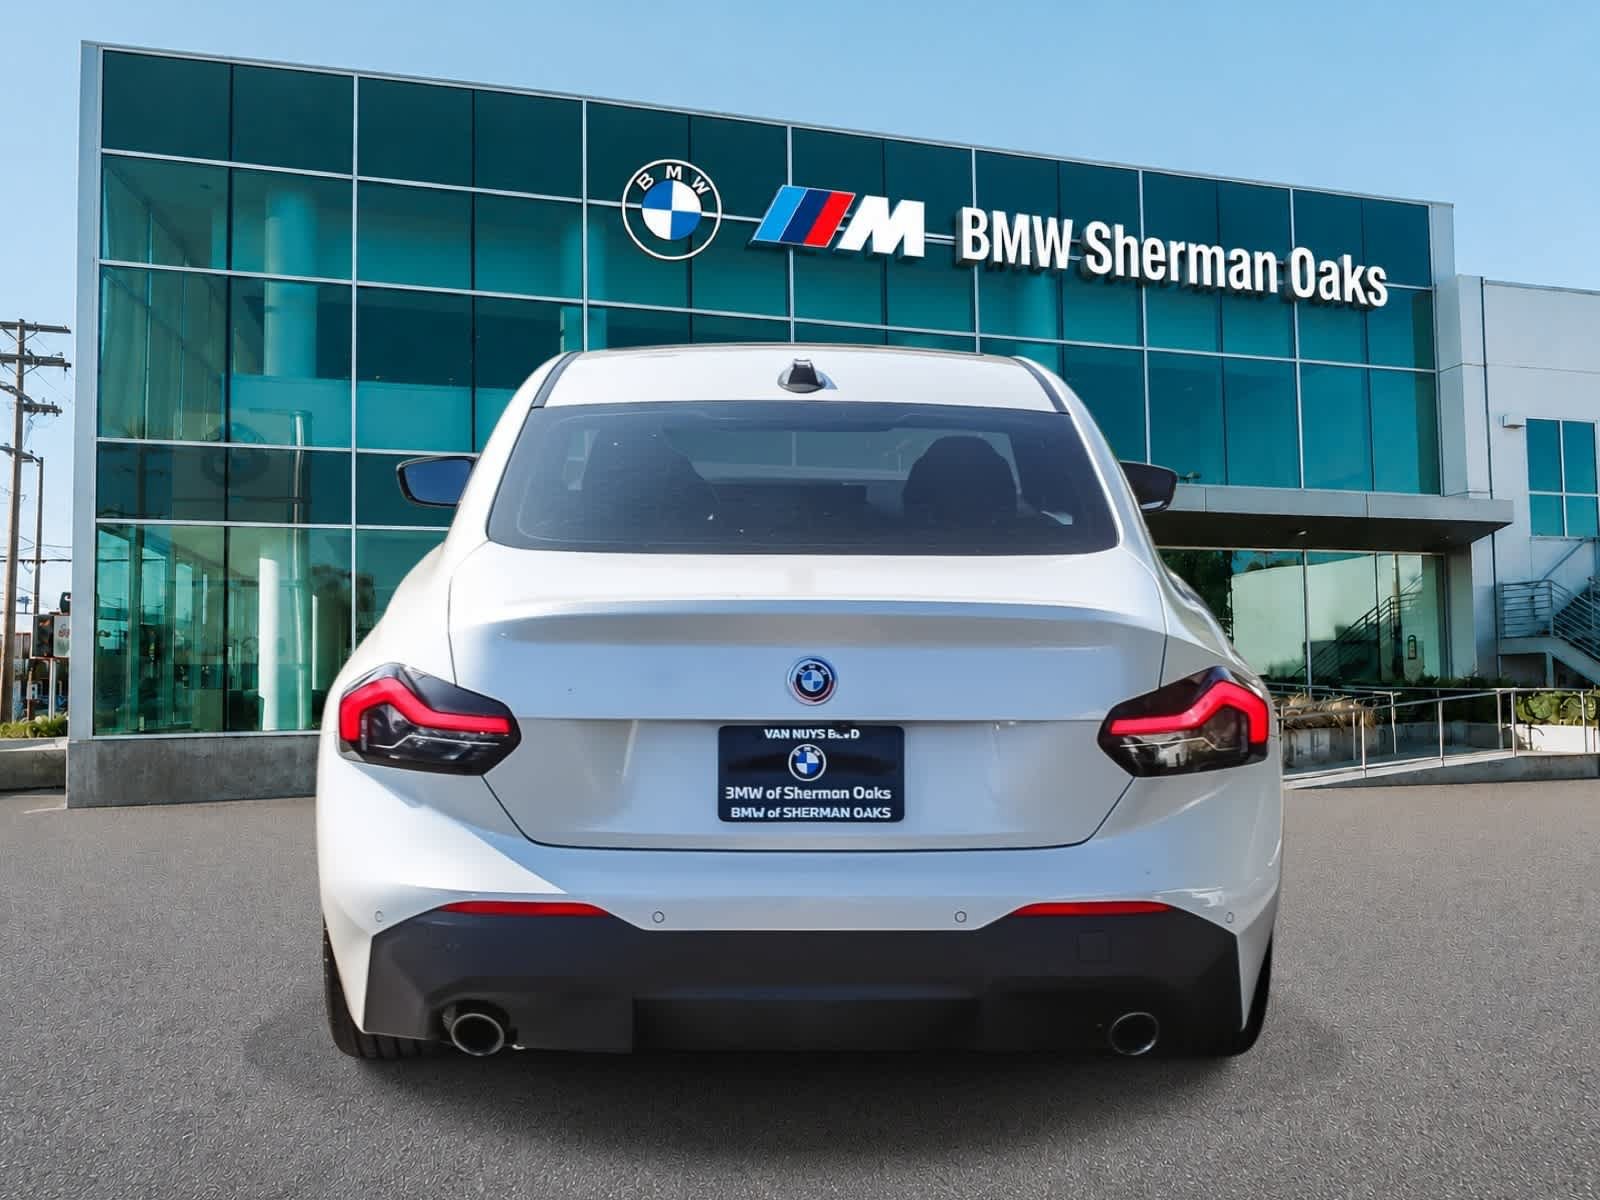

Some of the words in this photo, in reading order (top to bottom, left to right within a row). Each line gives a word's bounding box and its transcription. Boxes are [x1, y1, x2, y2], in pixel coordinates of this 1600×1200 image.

[636, 165, 711, 195] BMW
[961, 206, 1073, 270] BMW
[1085, 220, 1278, 293] Sherman
[1290, 246, 1388, 307] Oaks
[764, 728, 790, 739] VAN
[792, 728, 826, 739] NUYS
[766, 786, 782, 800] of
[783, 786, 850, 800] Sherman
[853, 786, 892, 800] Oaks
[731, 807, 765, 818] BMW
[767, 807, 781, 818] of
[783, 807, 850, 818] SHERMAN
[853, 807, 892, 818] OAKS
